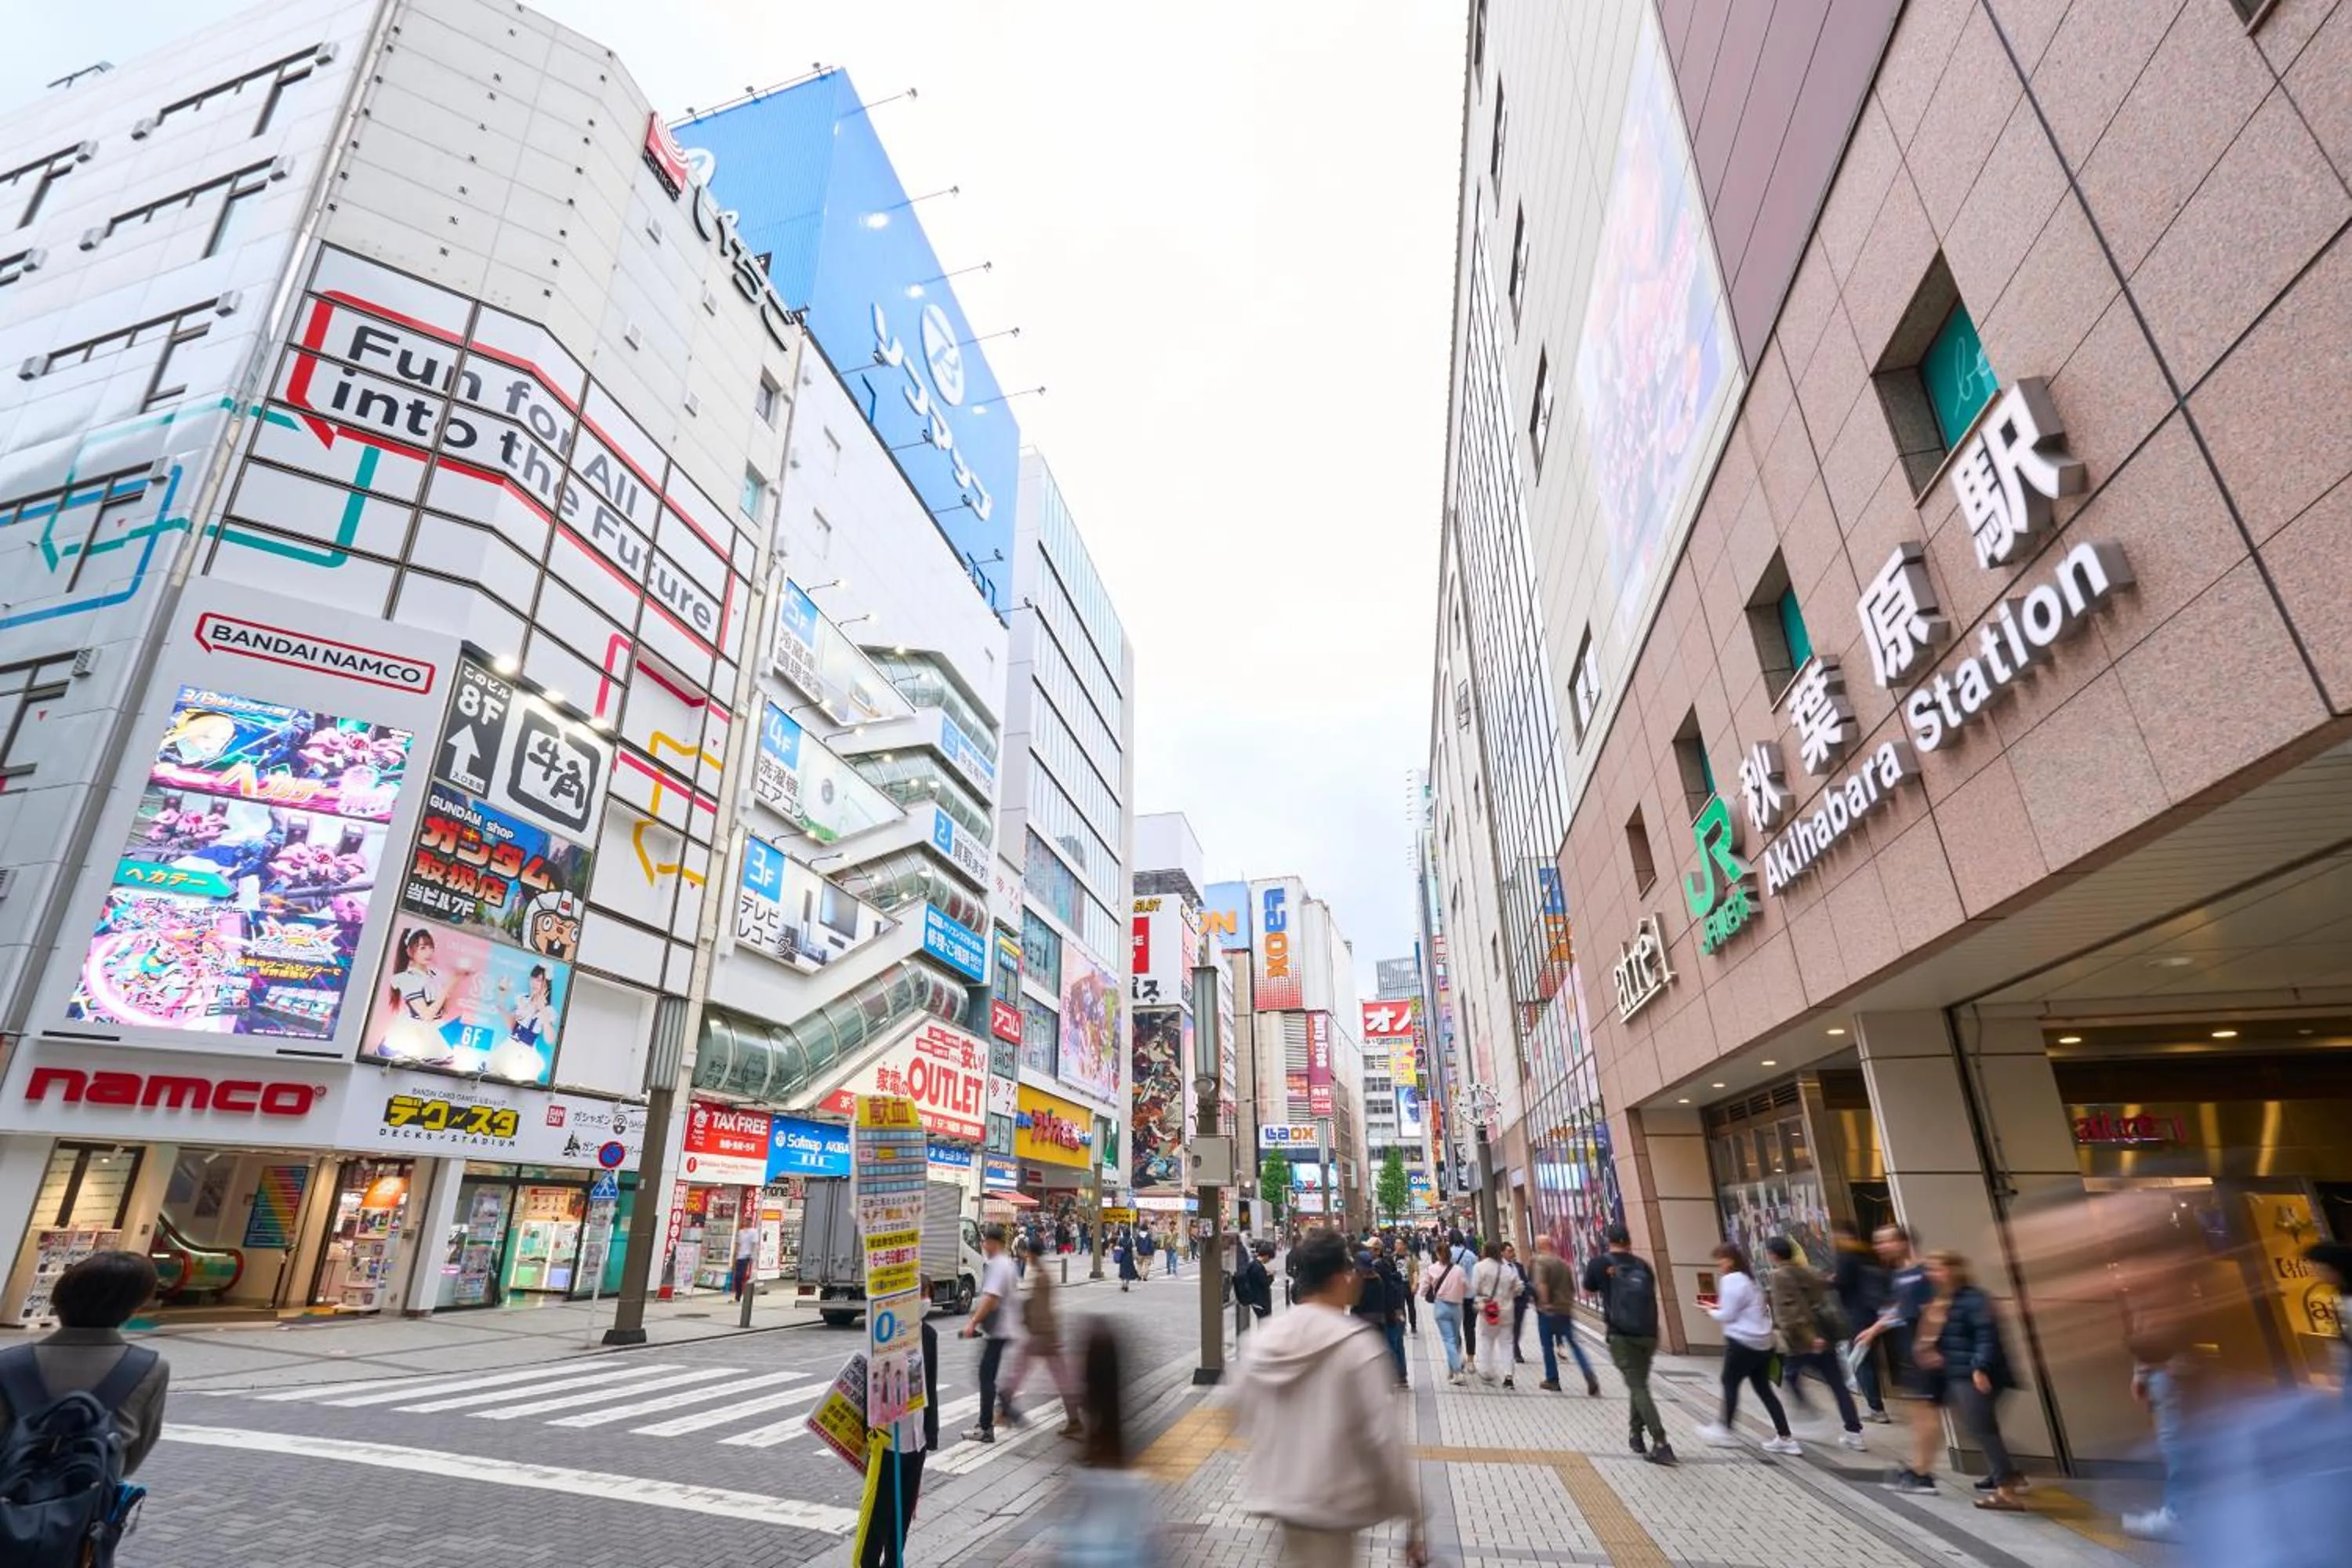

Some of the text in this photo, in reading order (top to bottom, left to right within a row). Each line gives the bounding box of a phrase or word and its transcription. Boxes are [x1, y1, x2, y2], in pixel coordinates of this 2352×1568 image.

[348, 324, 640, 519] Fun for All
[331, 366, 713, 630] into the Future
[1739, 384, 2070, 837] 秋葉原駅
[211, 624, 423, 685] BANDAI NAMCO
[463, 664, 510, 700] このビル
[457, 683, 505, 726] 8F
[1766, 539, 2121, 898] Akihabara Station
[768, 711, 792, 753] 4F
[527, 735, 586, 811] 牛角
[429, 793, 514, 840] GUNDAM shop
[757, 777, 808, 821] エアコン
[419, 815, 552, 892] ガンダム
[749, 846, 775, 887] 3F
[1685, 793, 1747, 918] JR
[125, 866, 209, 887] ヘカテー
[413, 848, 510, 909] 取扱店
[405, 881, 477, 918] 当ビル7F
[741, 895, 782, 930] テレビ
[738, 918, 801, 957] レコーダー
[994, 1006, 1020, 1039] アコム
[24, 1066, 315, 1116] namco
[907, 1057, 983, 1117] OUTLET
[573, 1111, 612, 1125] ガシャポン
[711, 1110, 768, 1135] TAX FREE
[868, 1097, 911, 1124] 献血
[451, 1134, 517, 1148] STADIUM
[786, 1133, 850, 1155] Sofmap AKIBA
